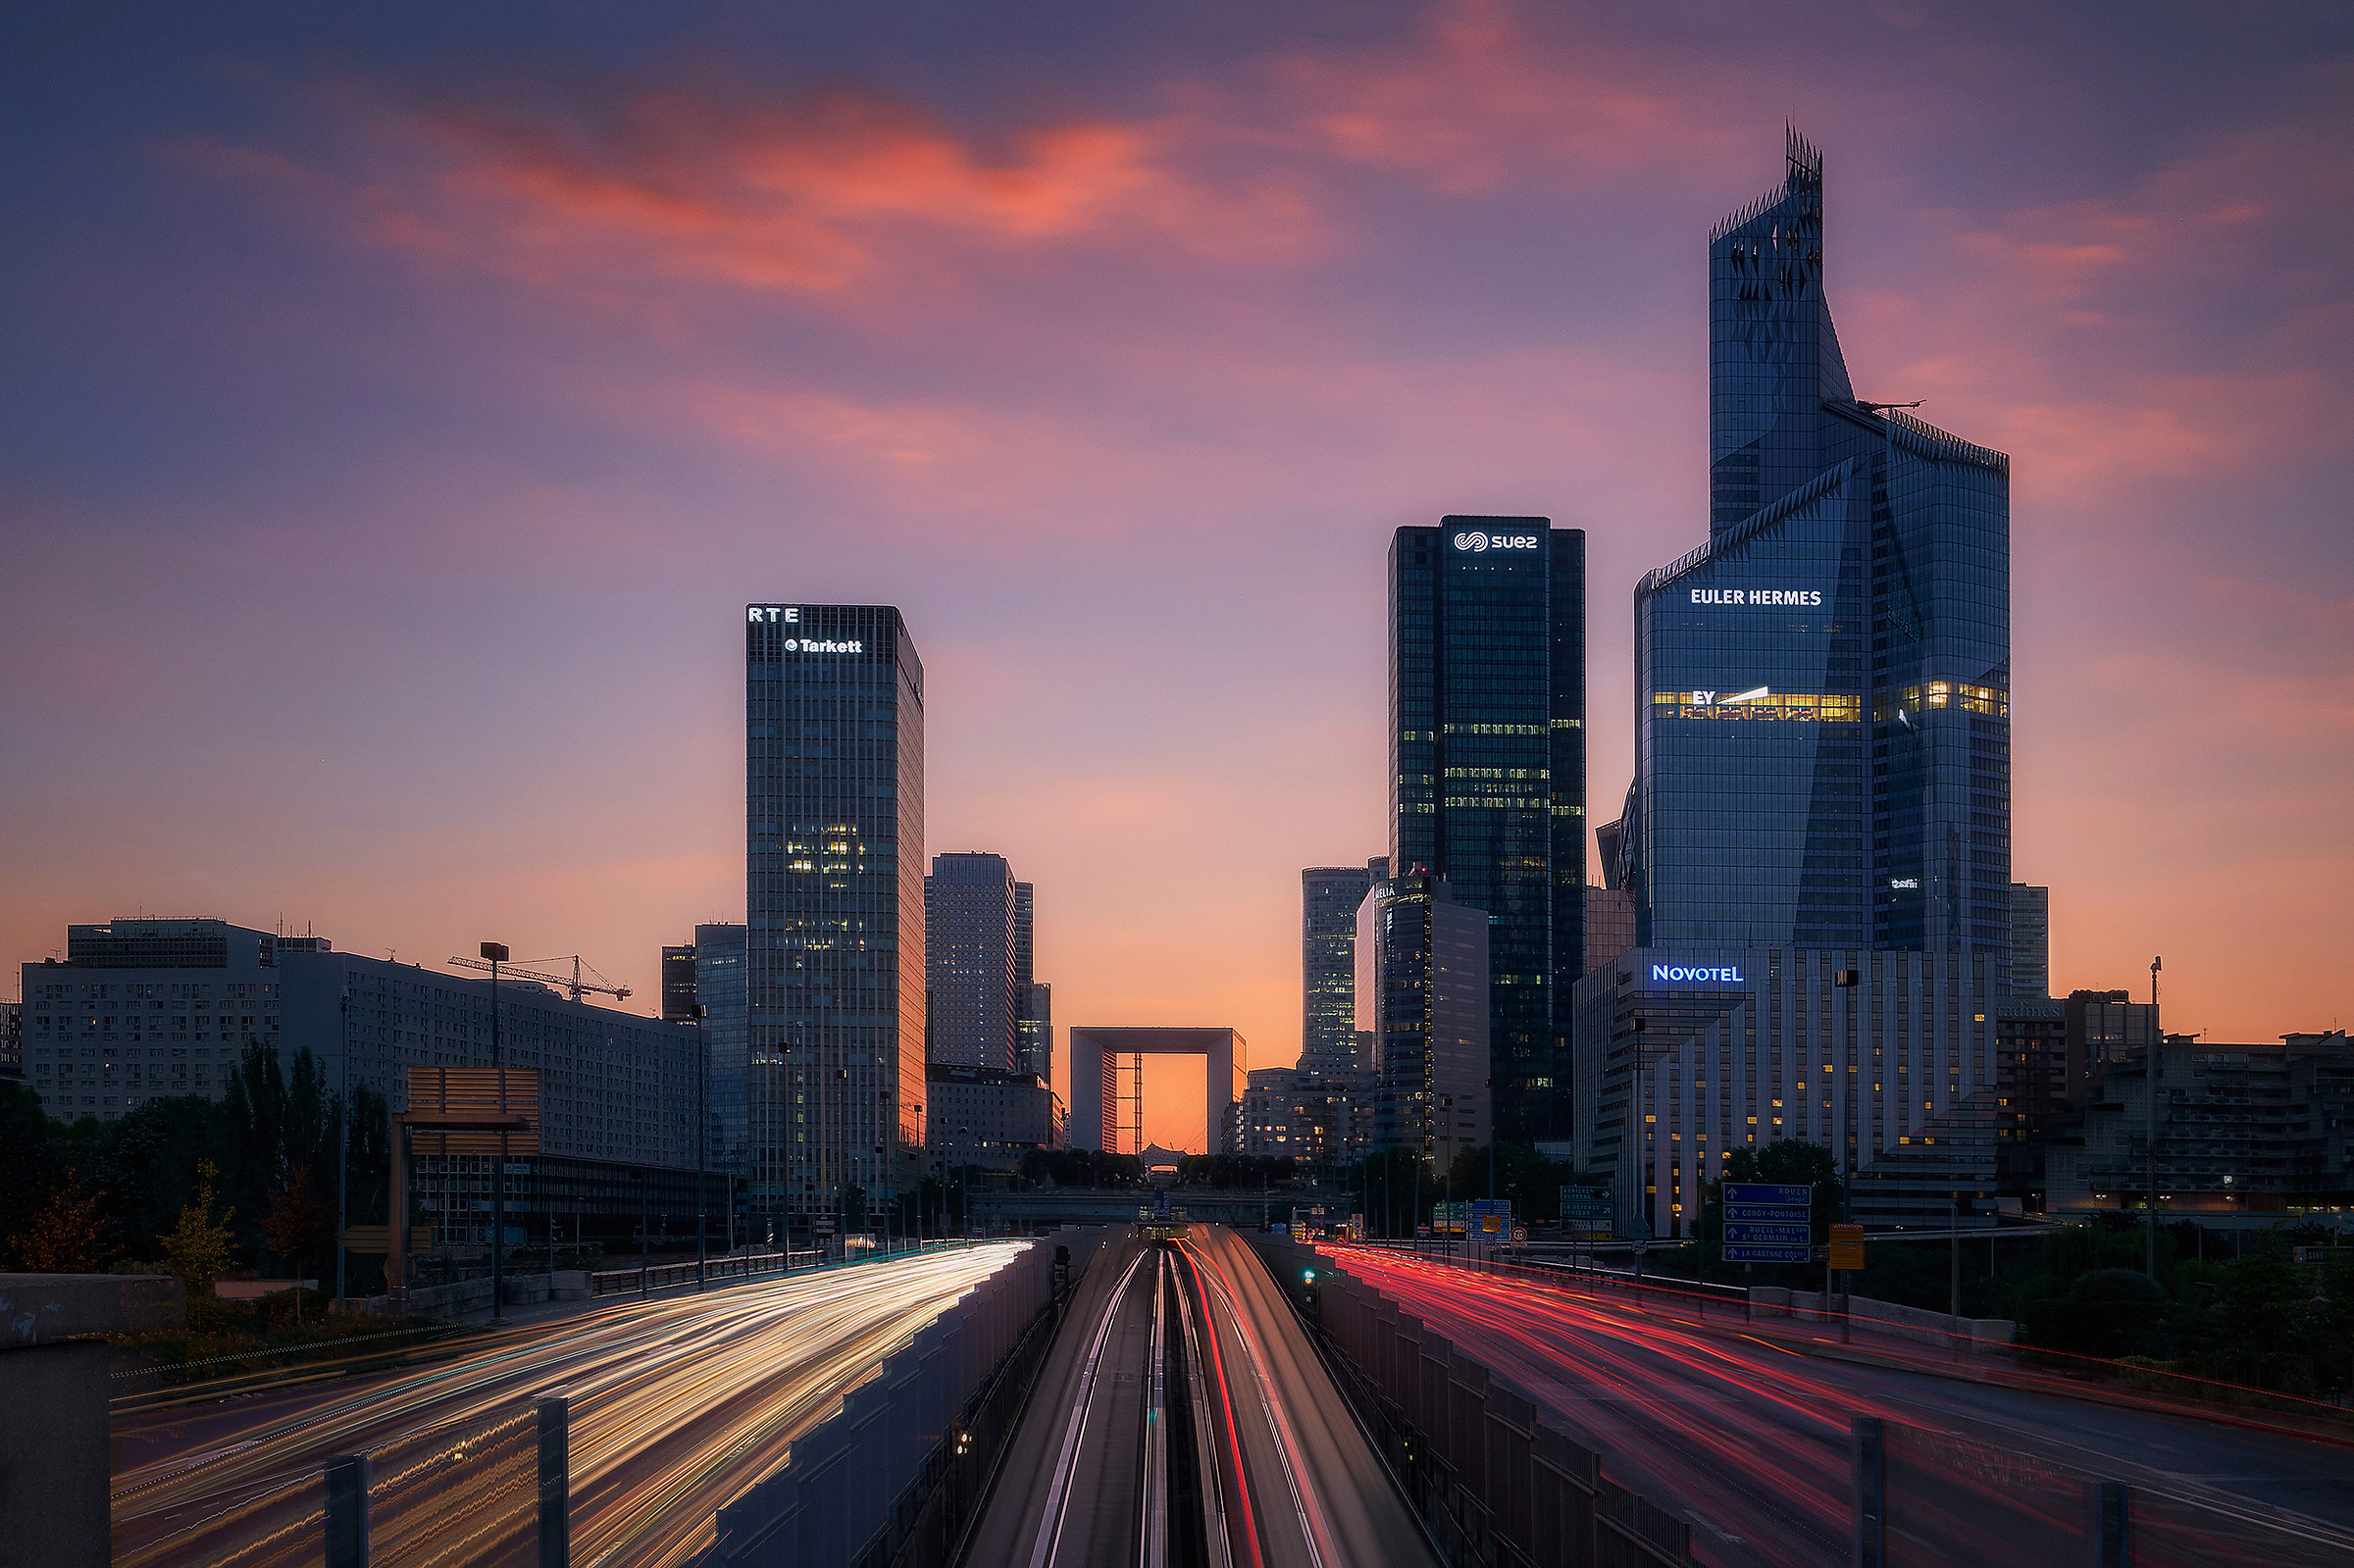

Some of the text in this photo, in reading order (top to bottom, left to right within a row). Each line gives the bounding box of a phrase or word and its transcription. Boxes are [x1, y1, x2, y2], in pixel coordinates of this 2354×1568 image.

[1691, 588, 1822, 606] EULER HERMES
[748, 607, 799, 624] RTE
[799, 638, 863, 654] Tarkett
[1692, 690, 1716, 705] EY
[1653, 964, 1745, 982] NOVOTEL
[1741, 1209, 1807, 1218] CERGY-PONTOISE
[1753, 1234, 1788, 1242] GERMAIN
